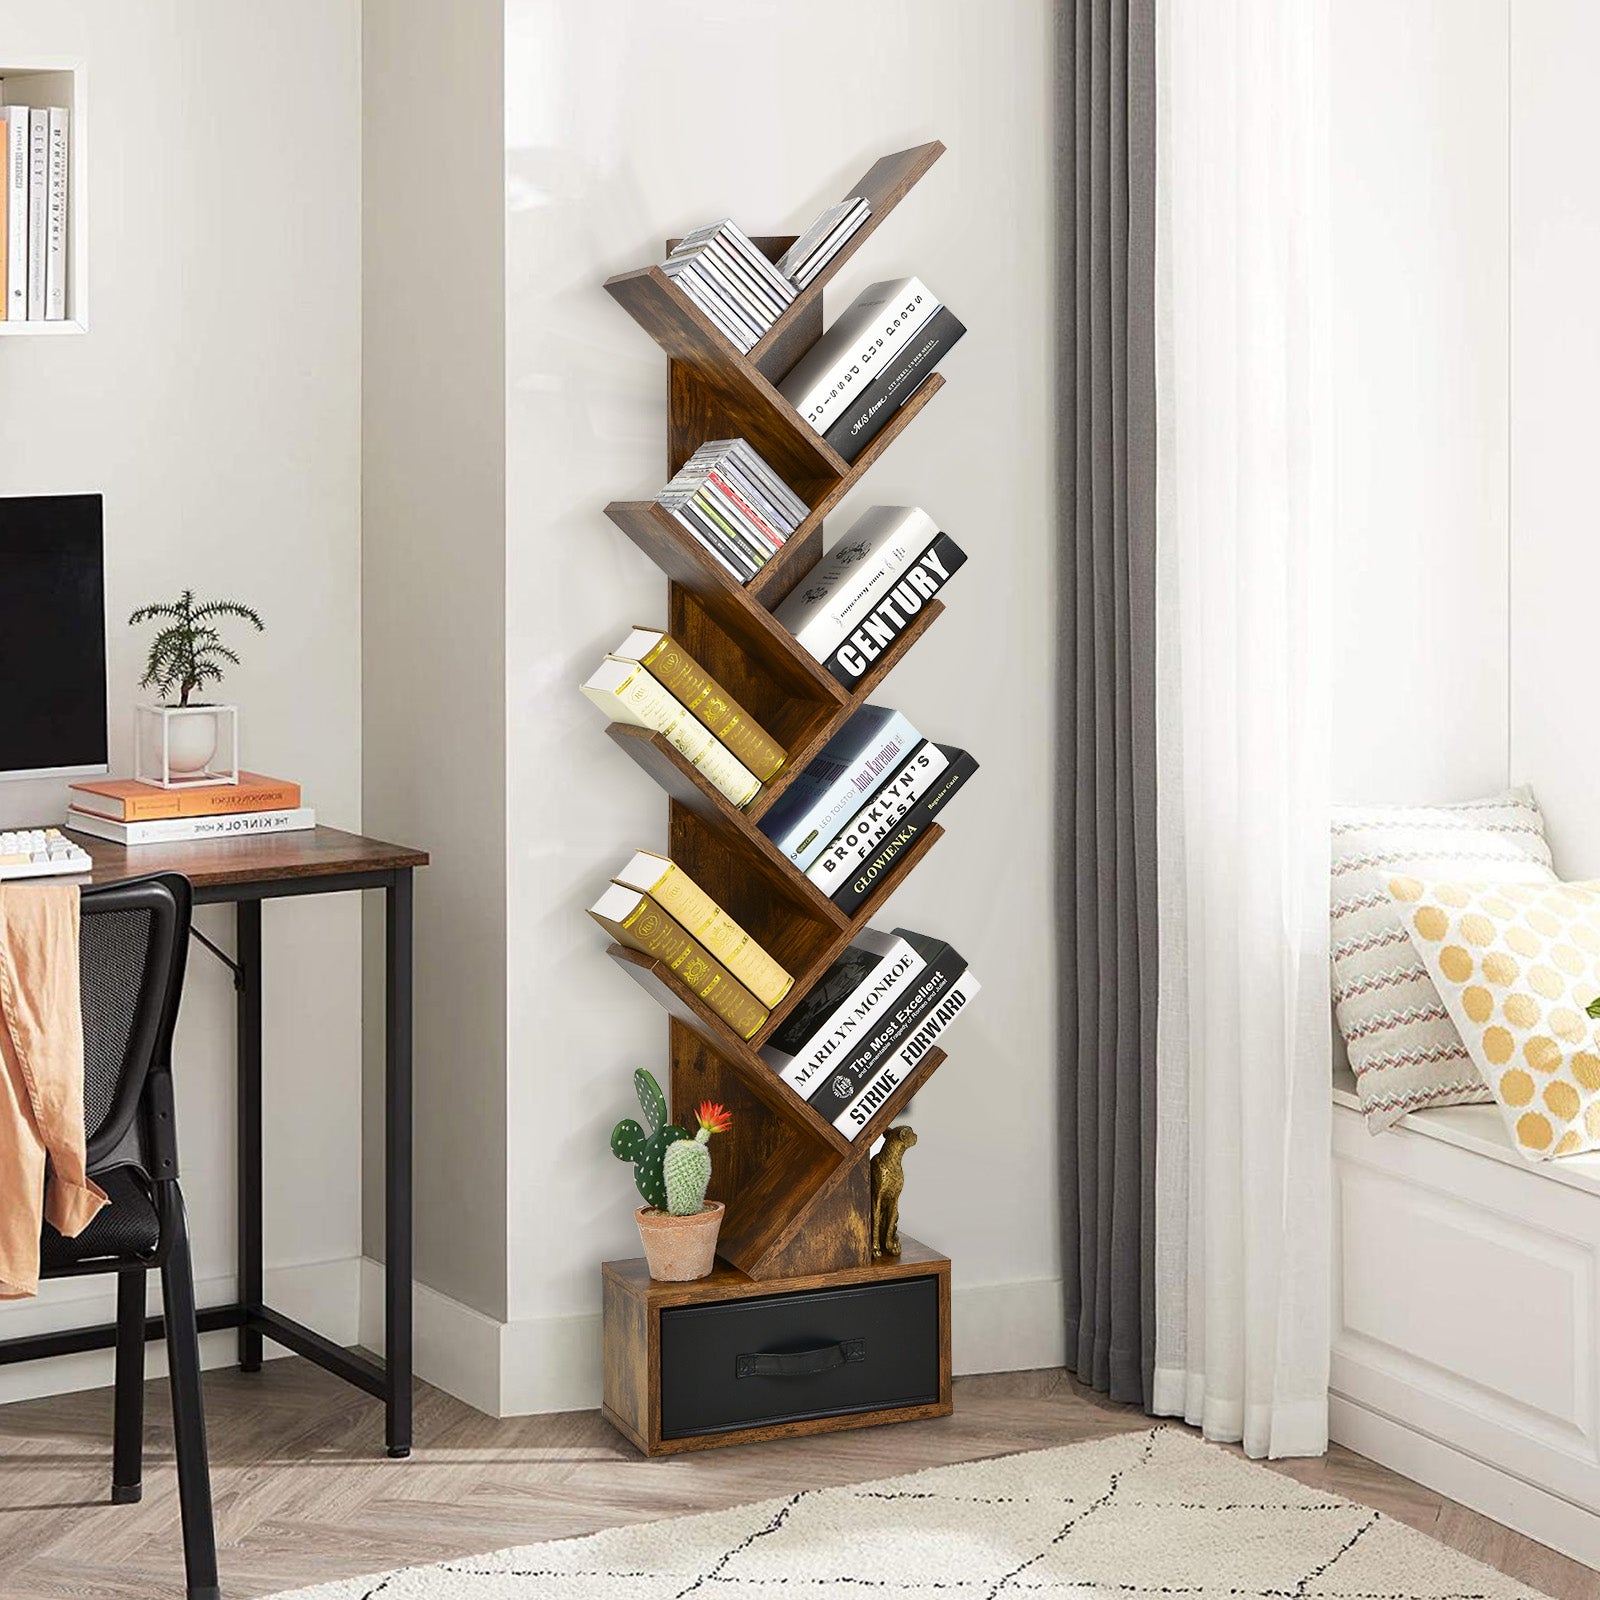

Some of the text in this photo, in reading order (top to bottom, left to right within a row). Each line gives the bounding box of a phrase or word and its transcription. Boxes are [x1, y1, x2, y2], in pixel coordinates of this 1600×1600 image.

[862, 338, 883, 364] and
[886, 295, 923, 336] speed
[808, 365, 860, 422] passion
[836, 548, 950, 677] CENTURY
[819, 740, 900, 830] LEO TOLSTOY Anna Karenina
[823, 755, 930, 873] BROOKLYN'S
[857, 791, 916, 858] FINEST
[794, 954, 914, 1087] MARILYN MONROE
[849, 970, 946, 1073] The Most Excellent
[849, 989, 968, 1126] STRIVE FORWARD
[857, 1068, 868, 1079] and
[866, 1042, 891, 1070] Lamentable
[890, 1023, 909, 1045] Tragedy
[912, 1000, 928, 1019] Romeo
[926, 990, 936, 1002] and
[934, 978, 947, 993] Juliet
